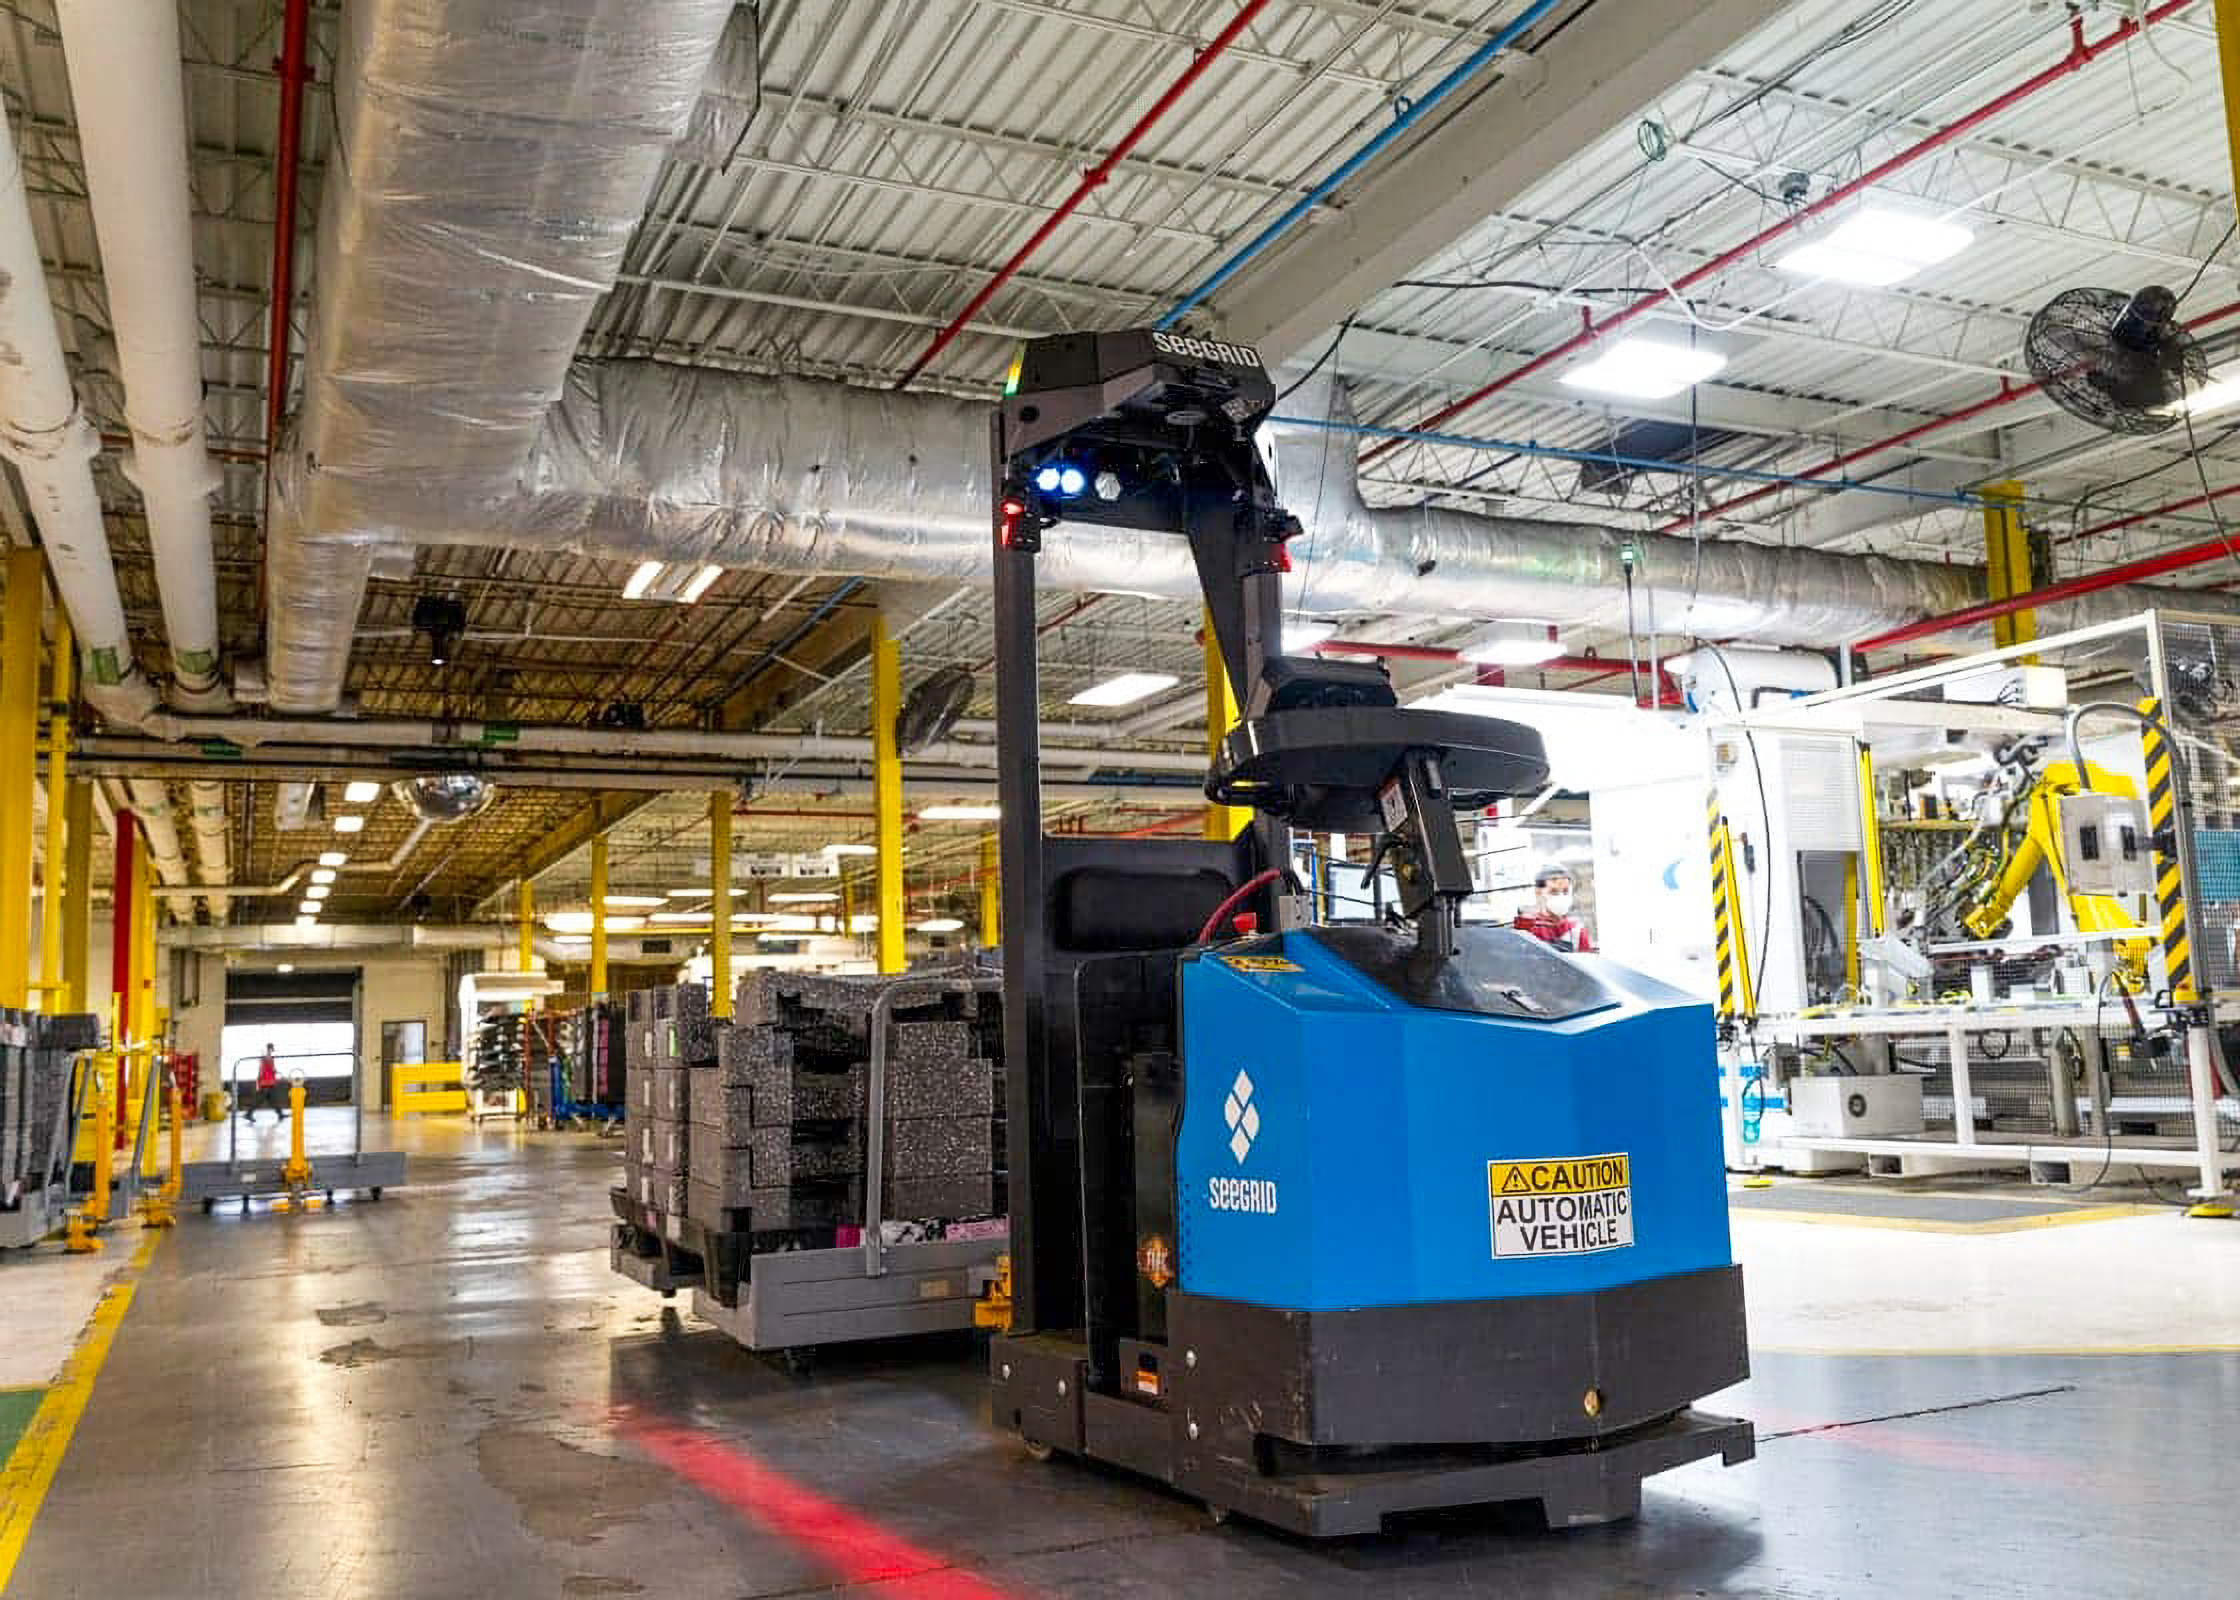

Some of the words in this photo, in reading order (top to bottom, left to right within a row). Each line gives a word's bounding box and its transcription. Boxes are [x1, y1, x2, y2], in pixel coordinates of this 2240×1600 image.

[1531, 1160, 1624, 1190] CAUTION
[1497, 1190, 1627, 1225] AUTOMATIC
[1520, 1218, 1618, 1251] VEHICLE
